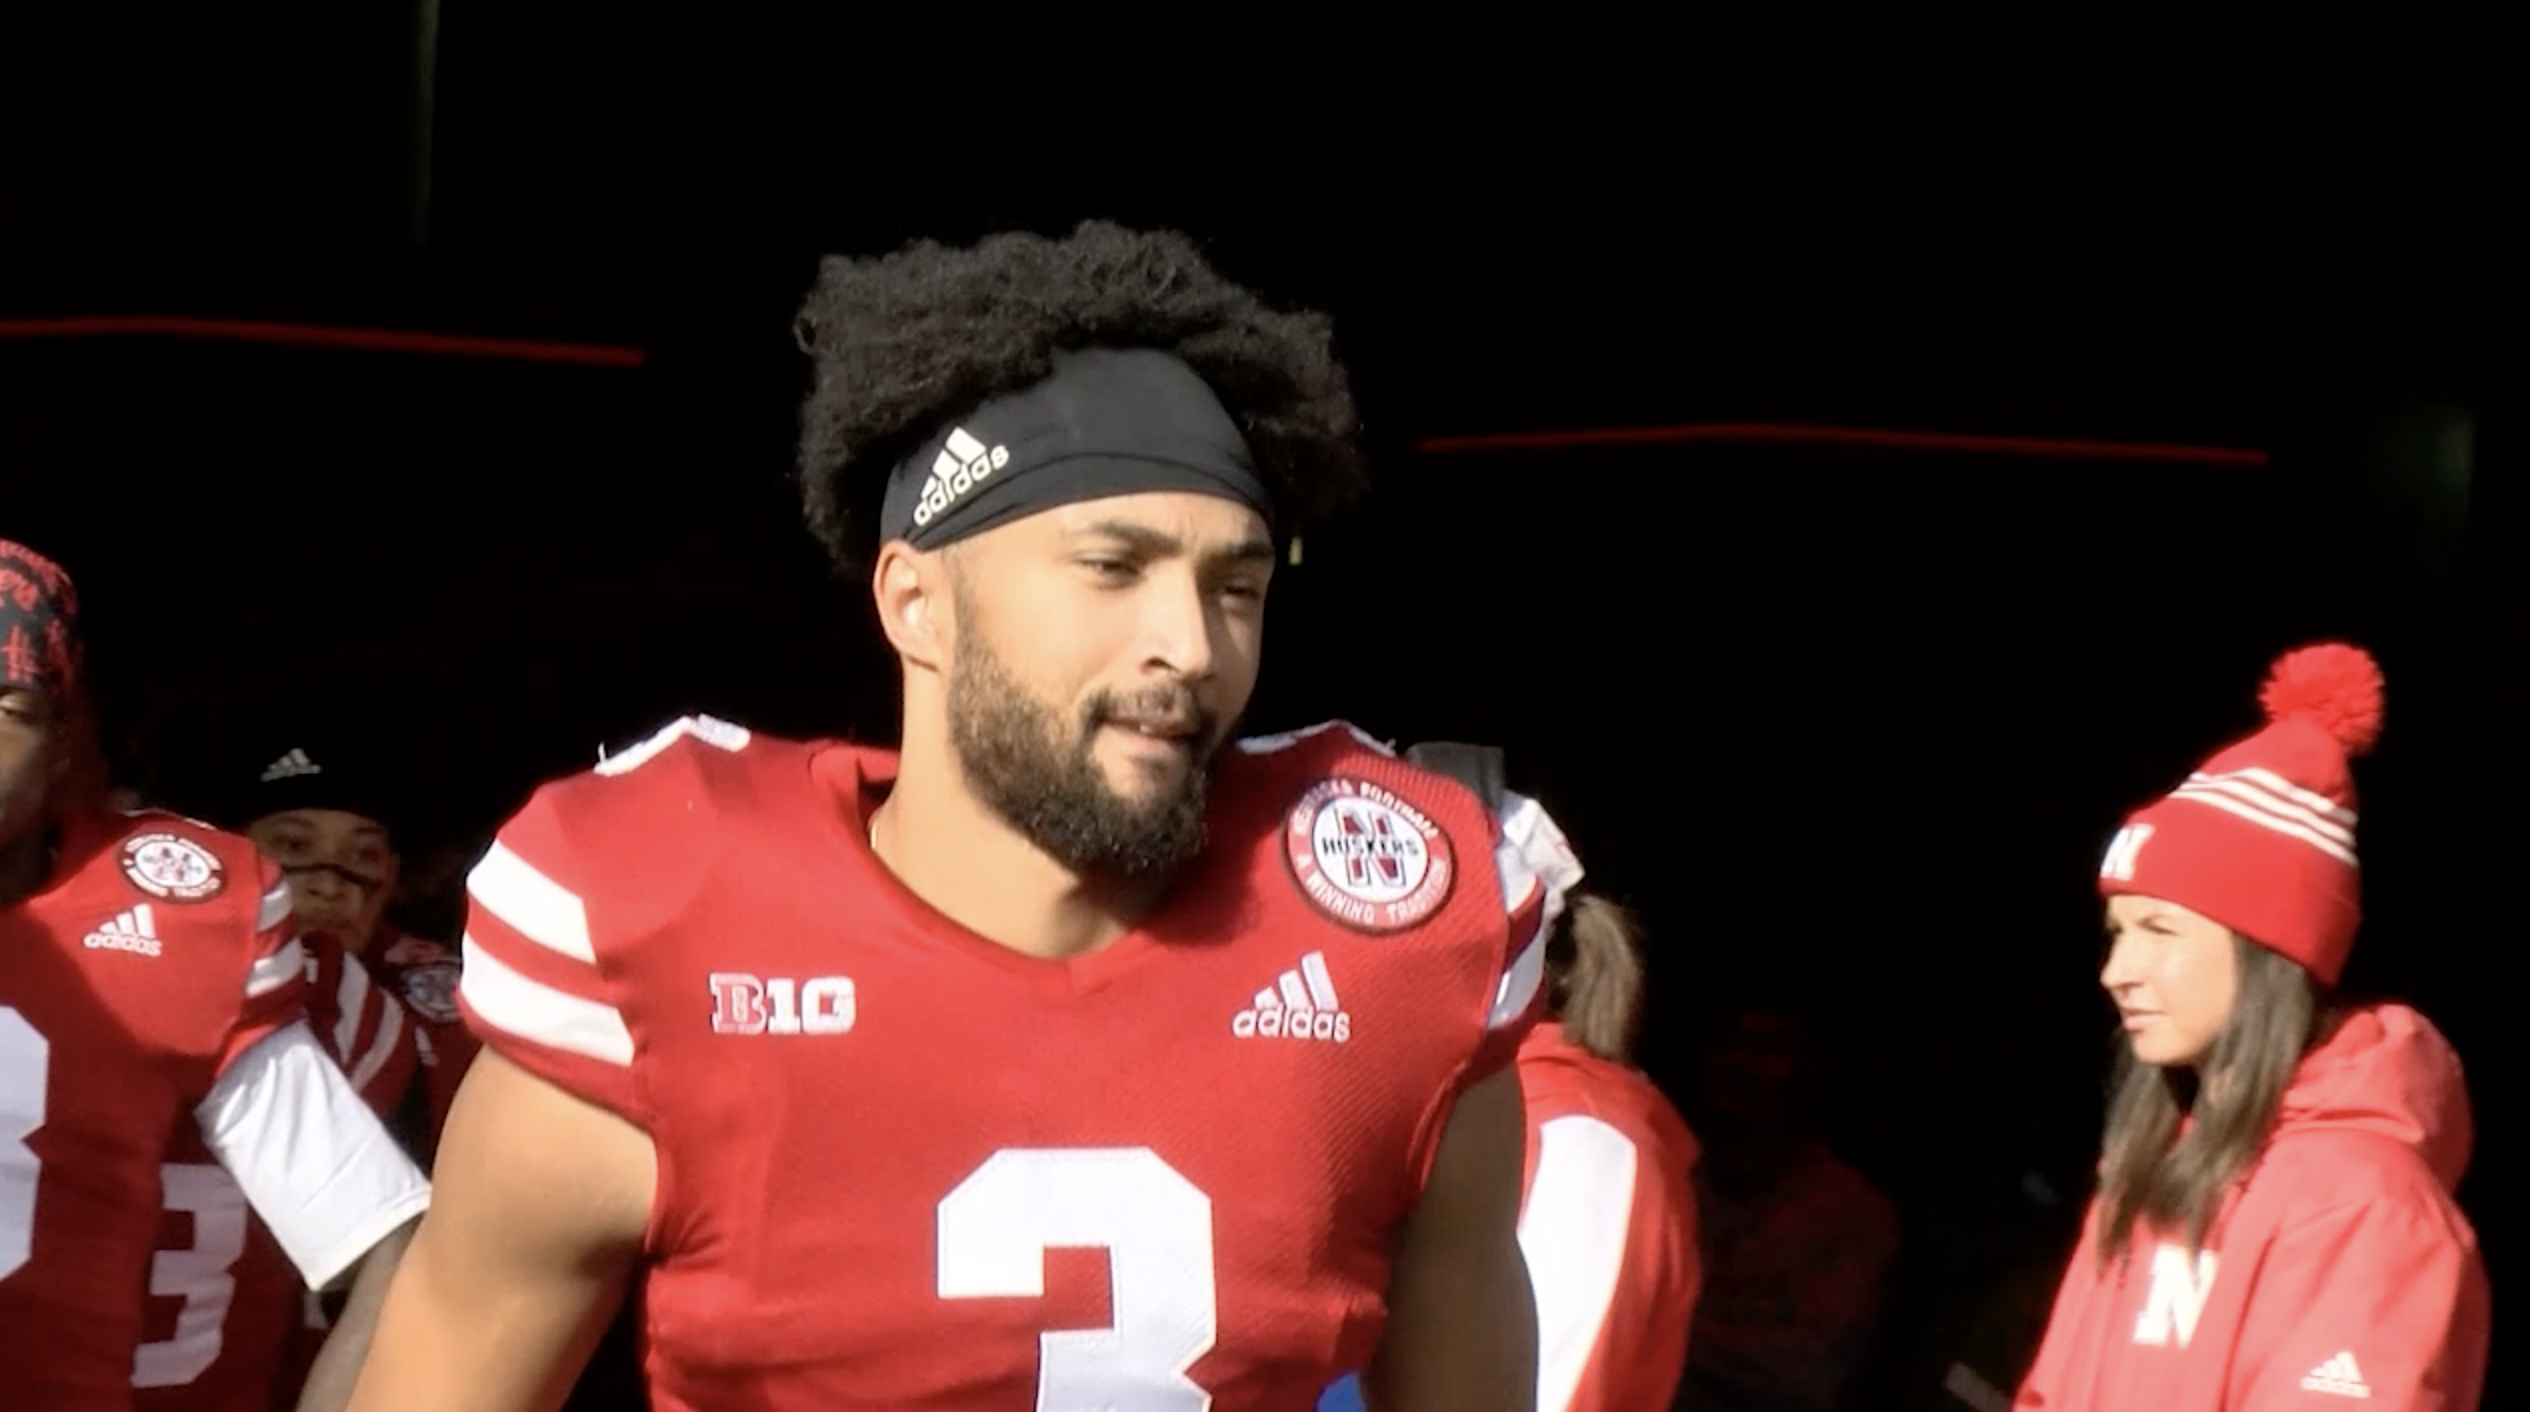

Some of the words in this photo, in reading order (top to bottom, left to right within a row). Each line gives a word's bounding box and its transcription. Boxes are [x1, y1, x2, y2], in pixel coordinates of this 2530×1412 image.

[913, 444, 1010, 526] adidas
[2100, 822, 2155, 881] N
[1232, 1001, 1350, 1043] adidas
[130, 1163, 248, 1389] 3
[937, 1147, 1217, 1412] 3
[2133, 1243, 2220, 1349] N
